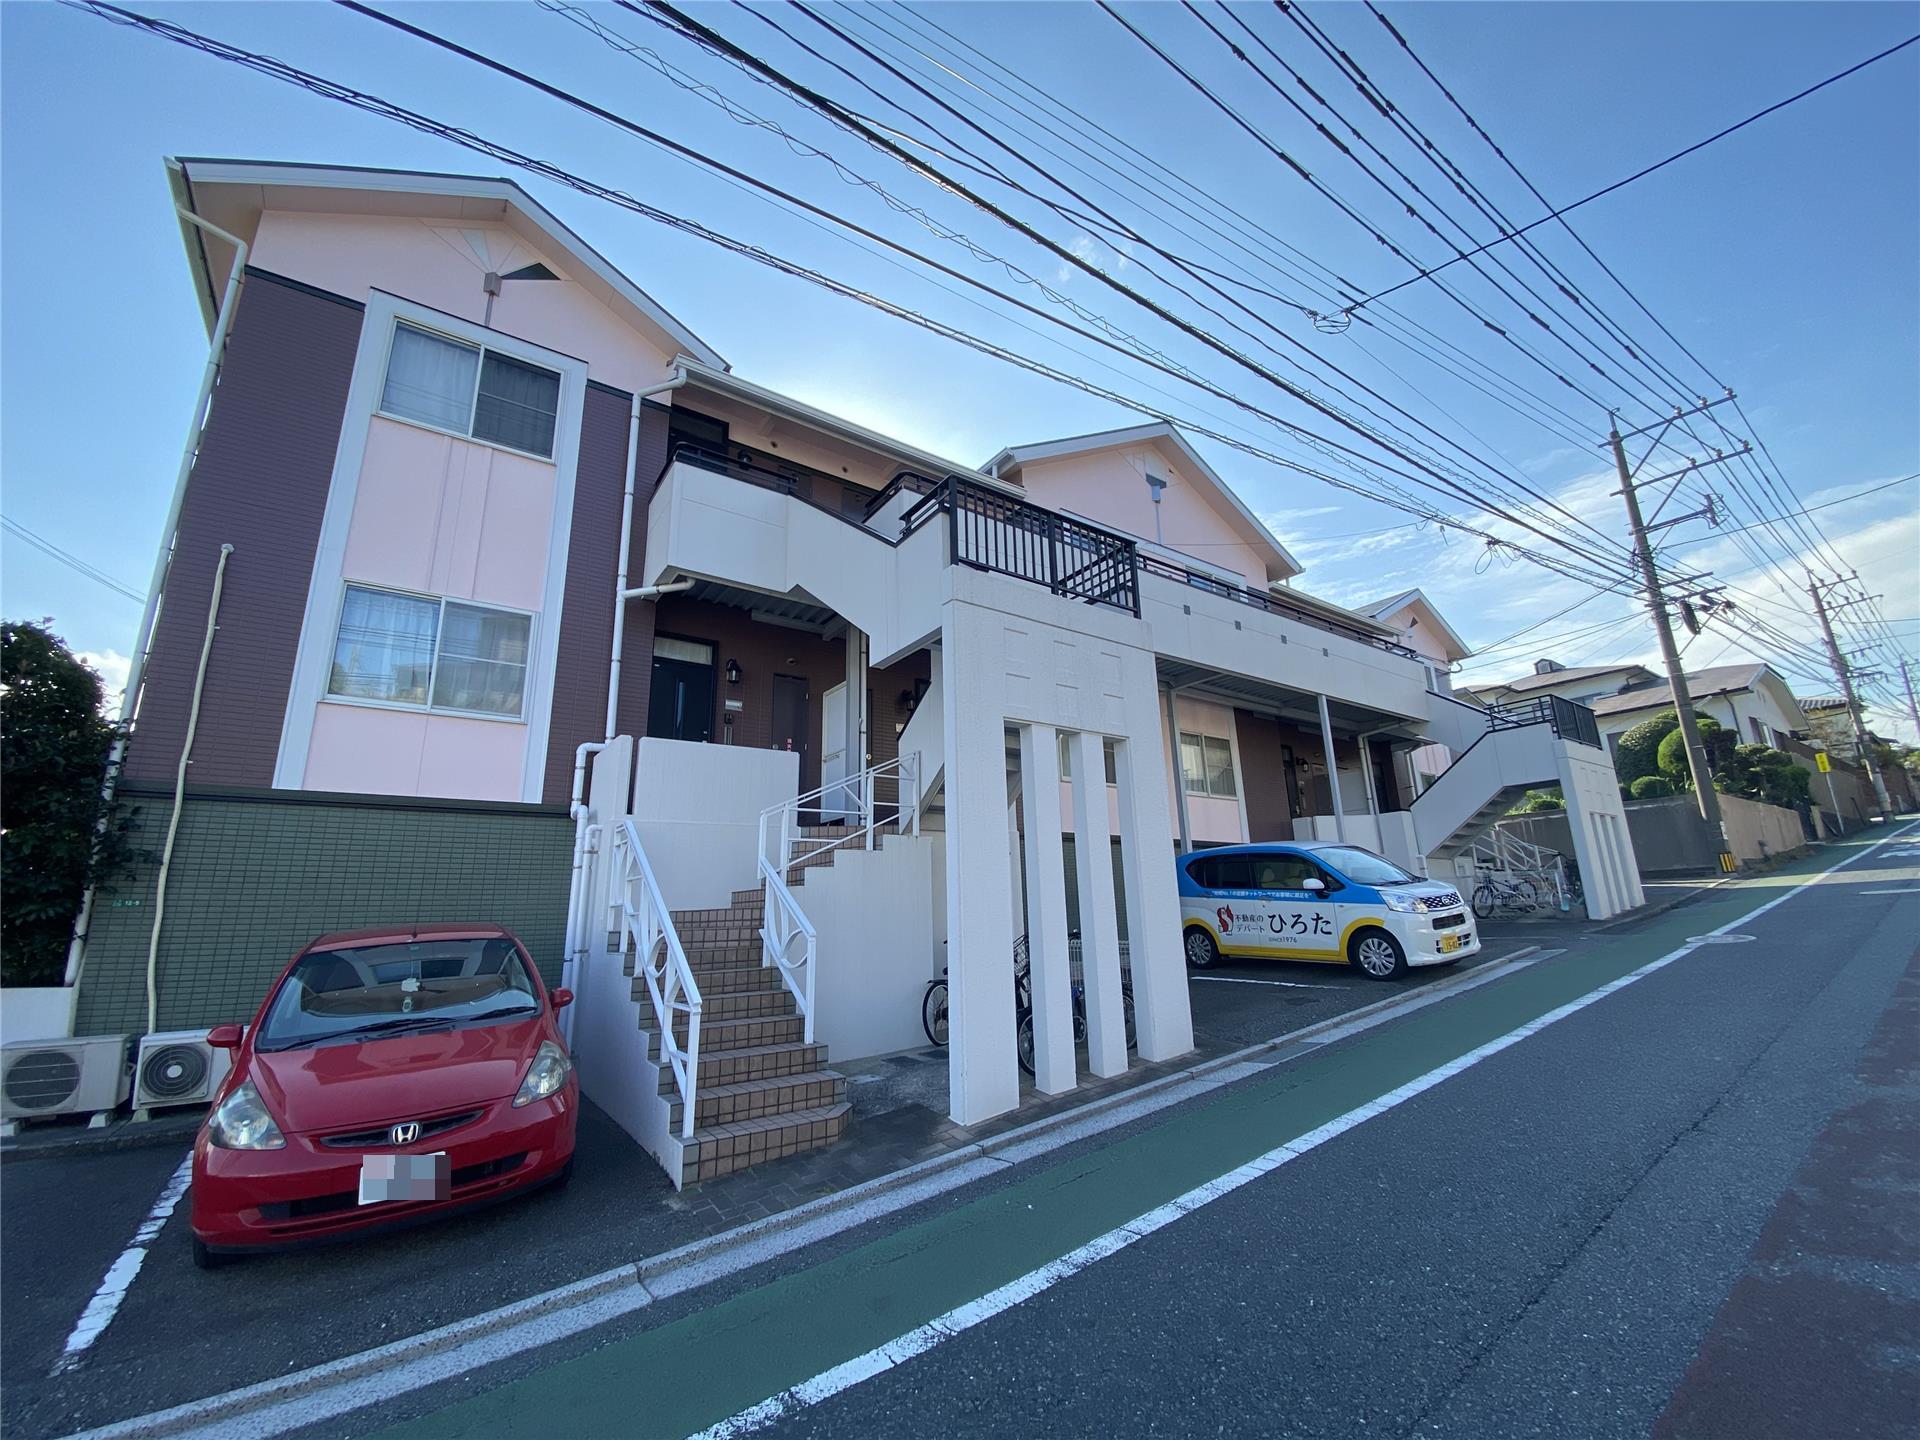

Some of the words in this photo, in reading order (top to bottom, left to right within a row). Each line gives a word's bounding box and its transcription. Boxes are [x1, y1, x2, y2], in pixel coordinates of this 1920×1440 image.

[1234, 914, 1264, 923] 不動産の
[1267, 912, 1333, 935] ひろた
[1235, 924, 1265, 933] デパート
